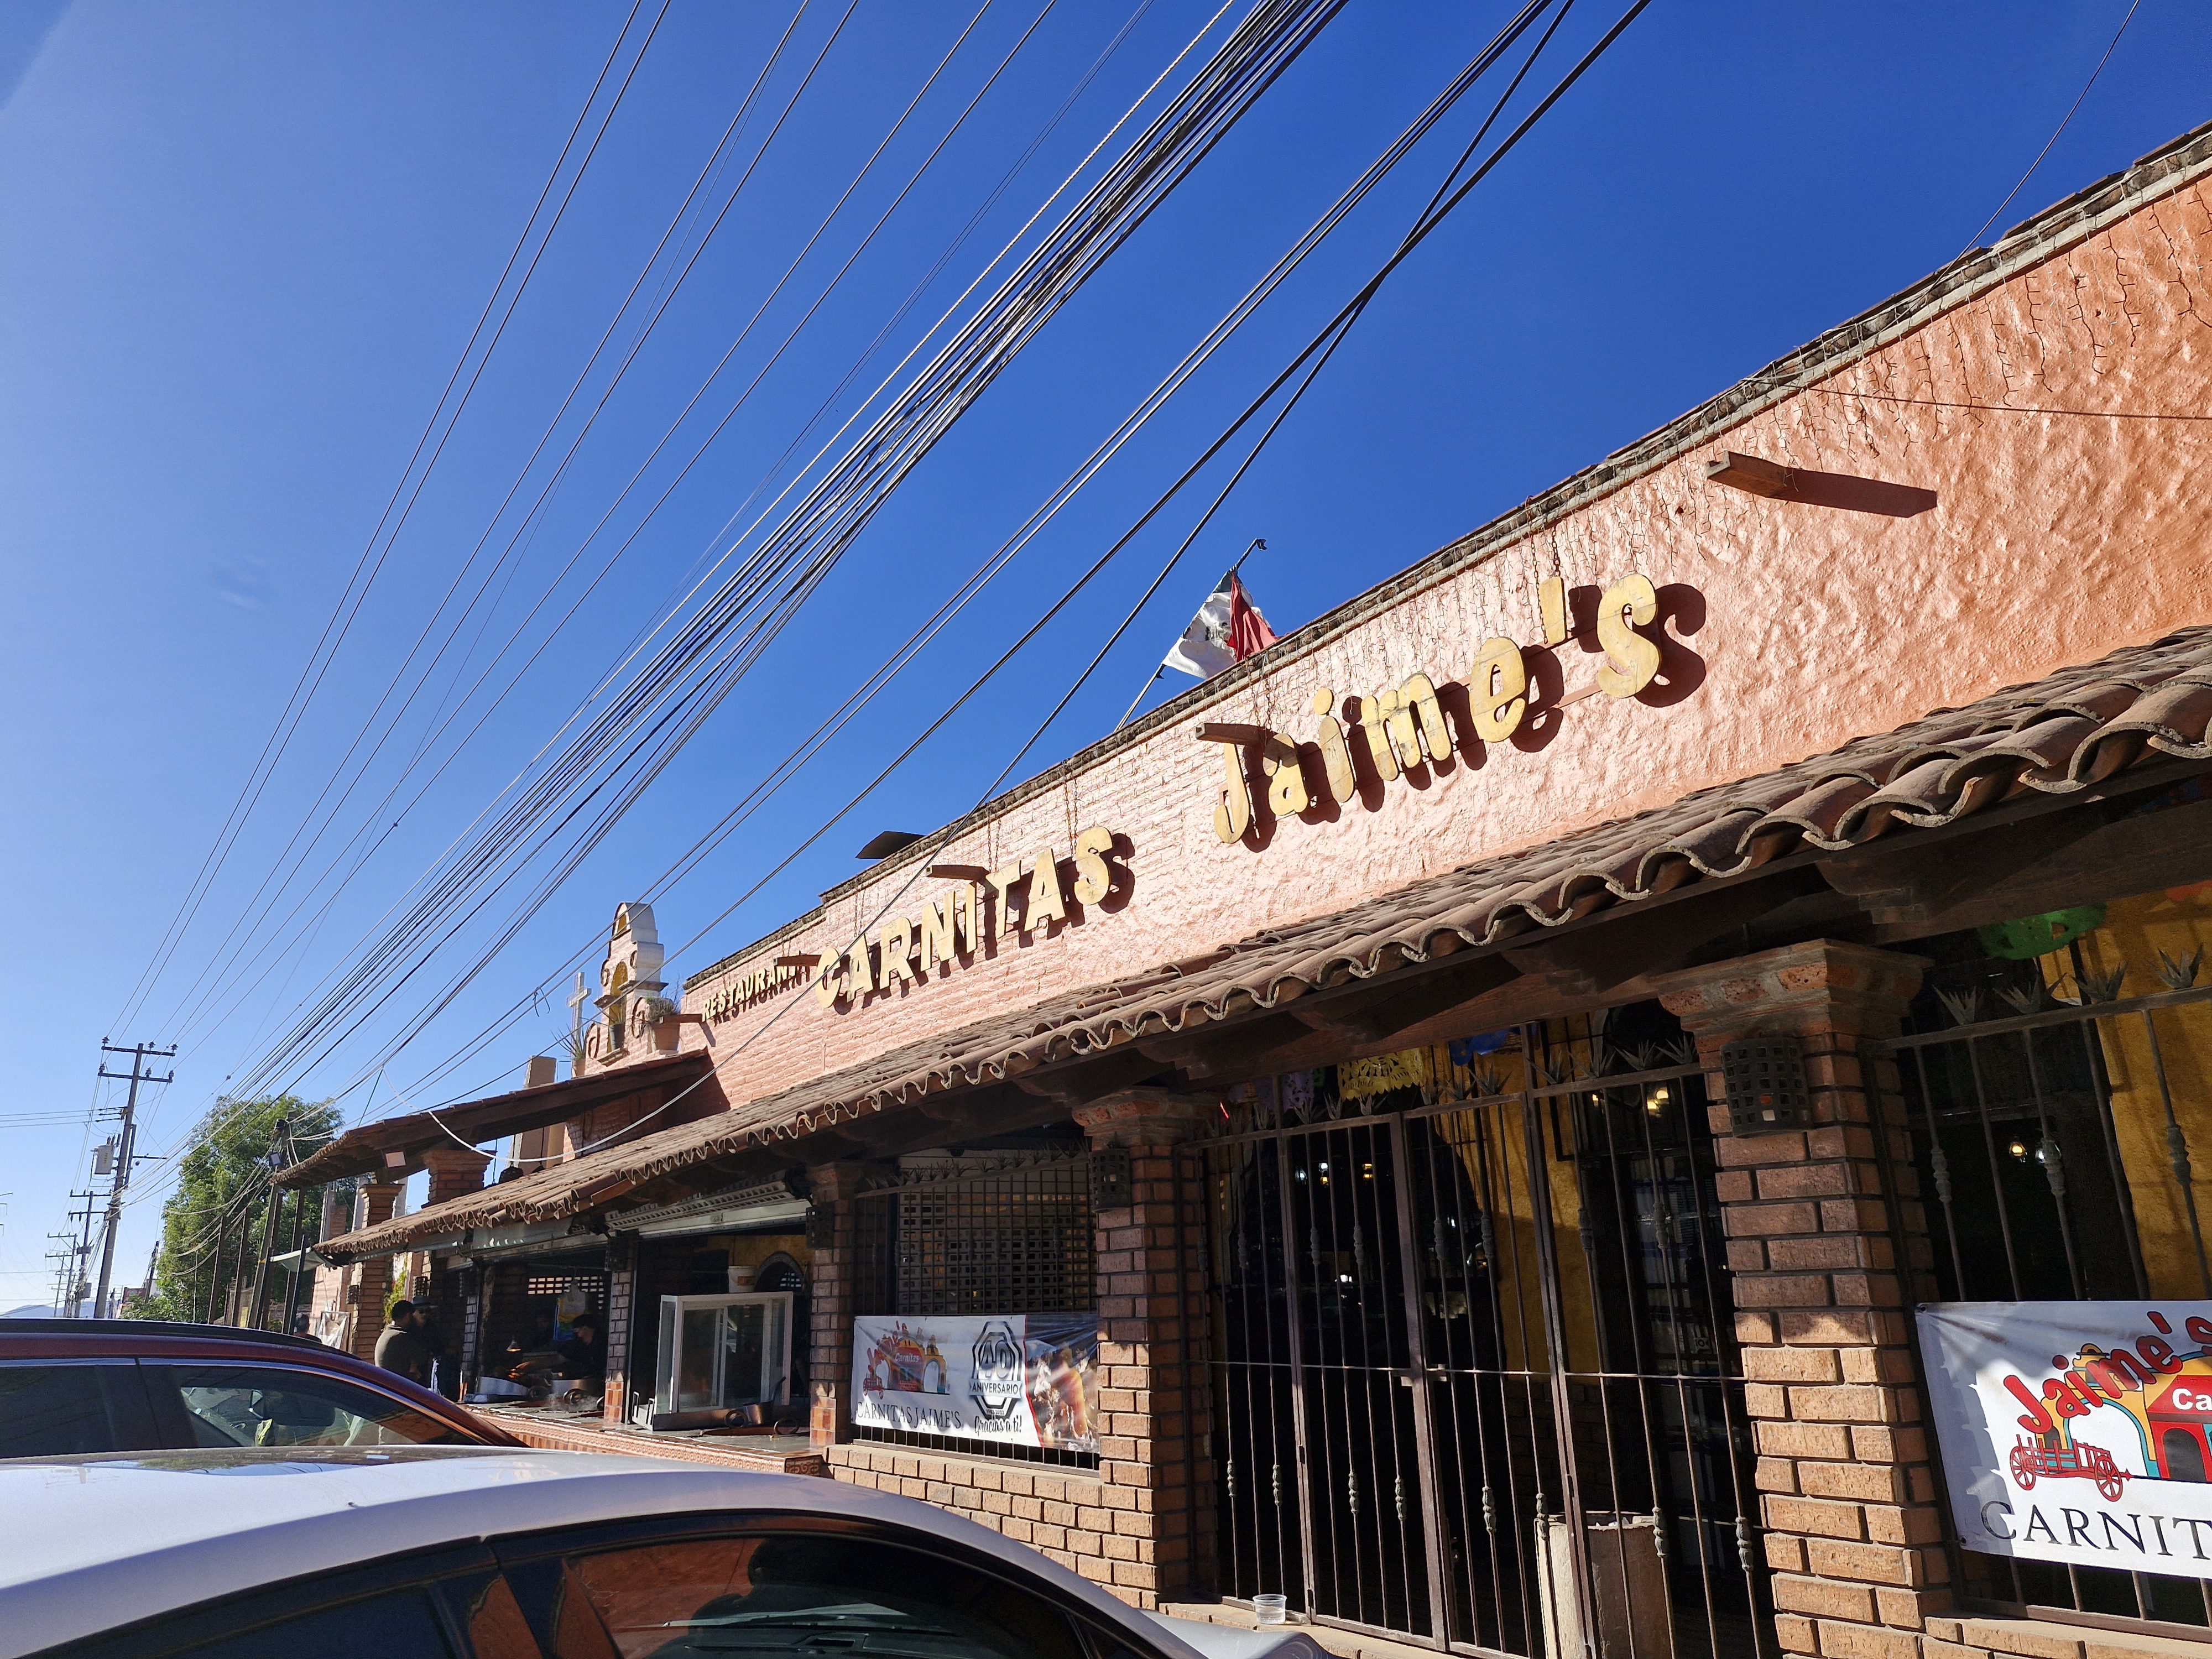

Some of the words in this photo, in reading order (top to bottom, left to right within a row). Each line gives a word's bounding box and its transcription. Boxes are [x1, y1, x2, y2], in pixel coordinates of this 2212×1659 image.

[1214, 573, 1661, 844] Jaime's
[816, 826, 1113, 1008] CARNITAS
[894, 1353, 920, 1363] Carnitas
[979, 1339, 1012, 1379] 40
[972, 1382, 1019, 1395] ANIVERSARIO
[858, 1401, 912, 1423] CARNITAS
[914, 1407, 961, 1429] JAIME'S
[974, 1415, 1004, 1437] Gracias
[1006, 1420, 1012, 1431] a
[1013, 1415, 1022, 1432] ti!
[1981, 1500, 2212, 1560] CARNIT
